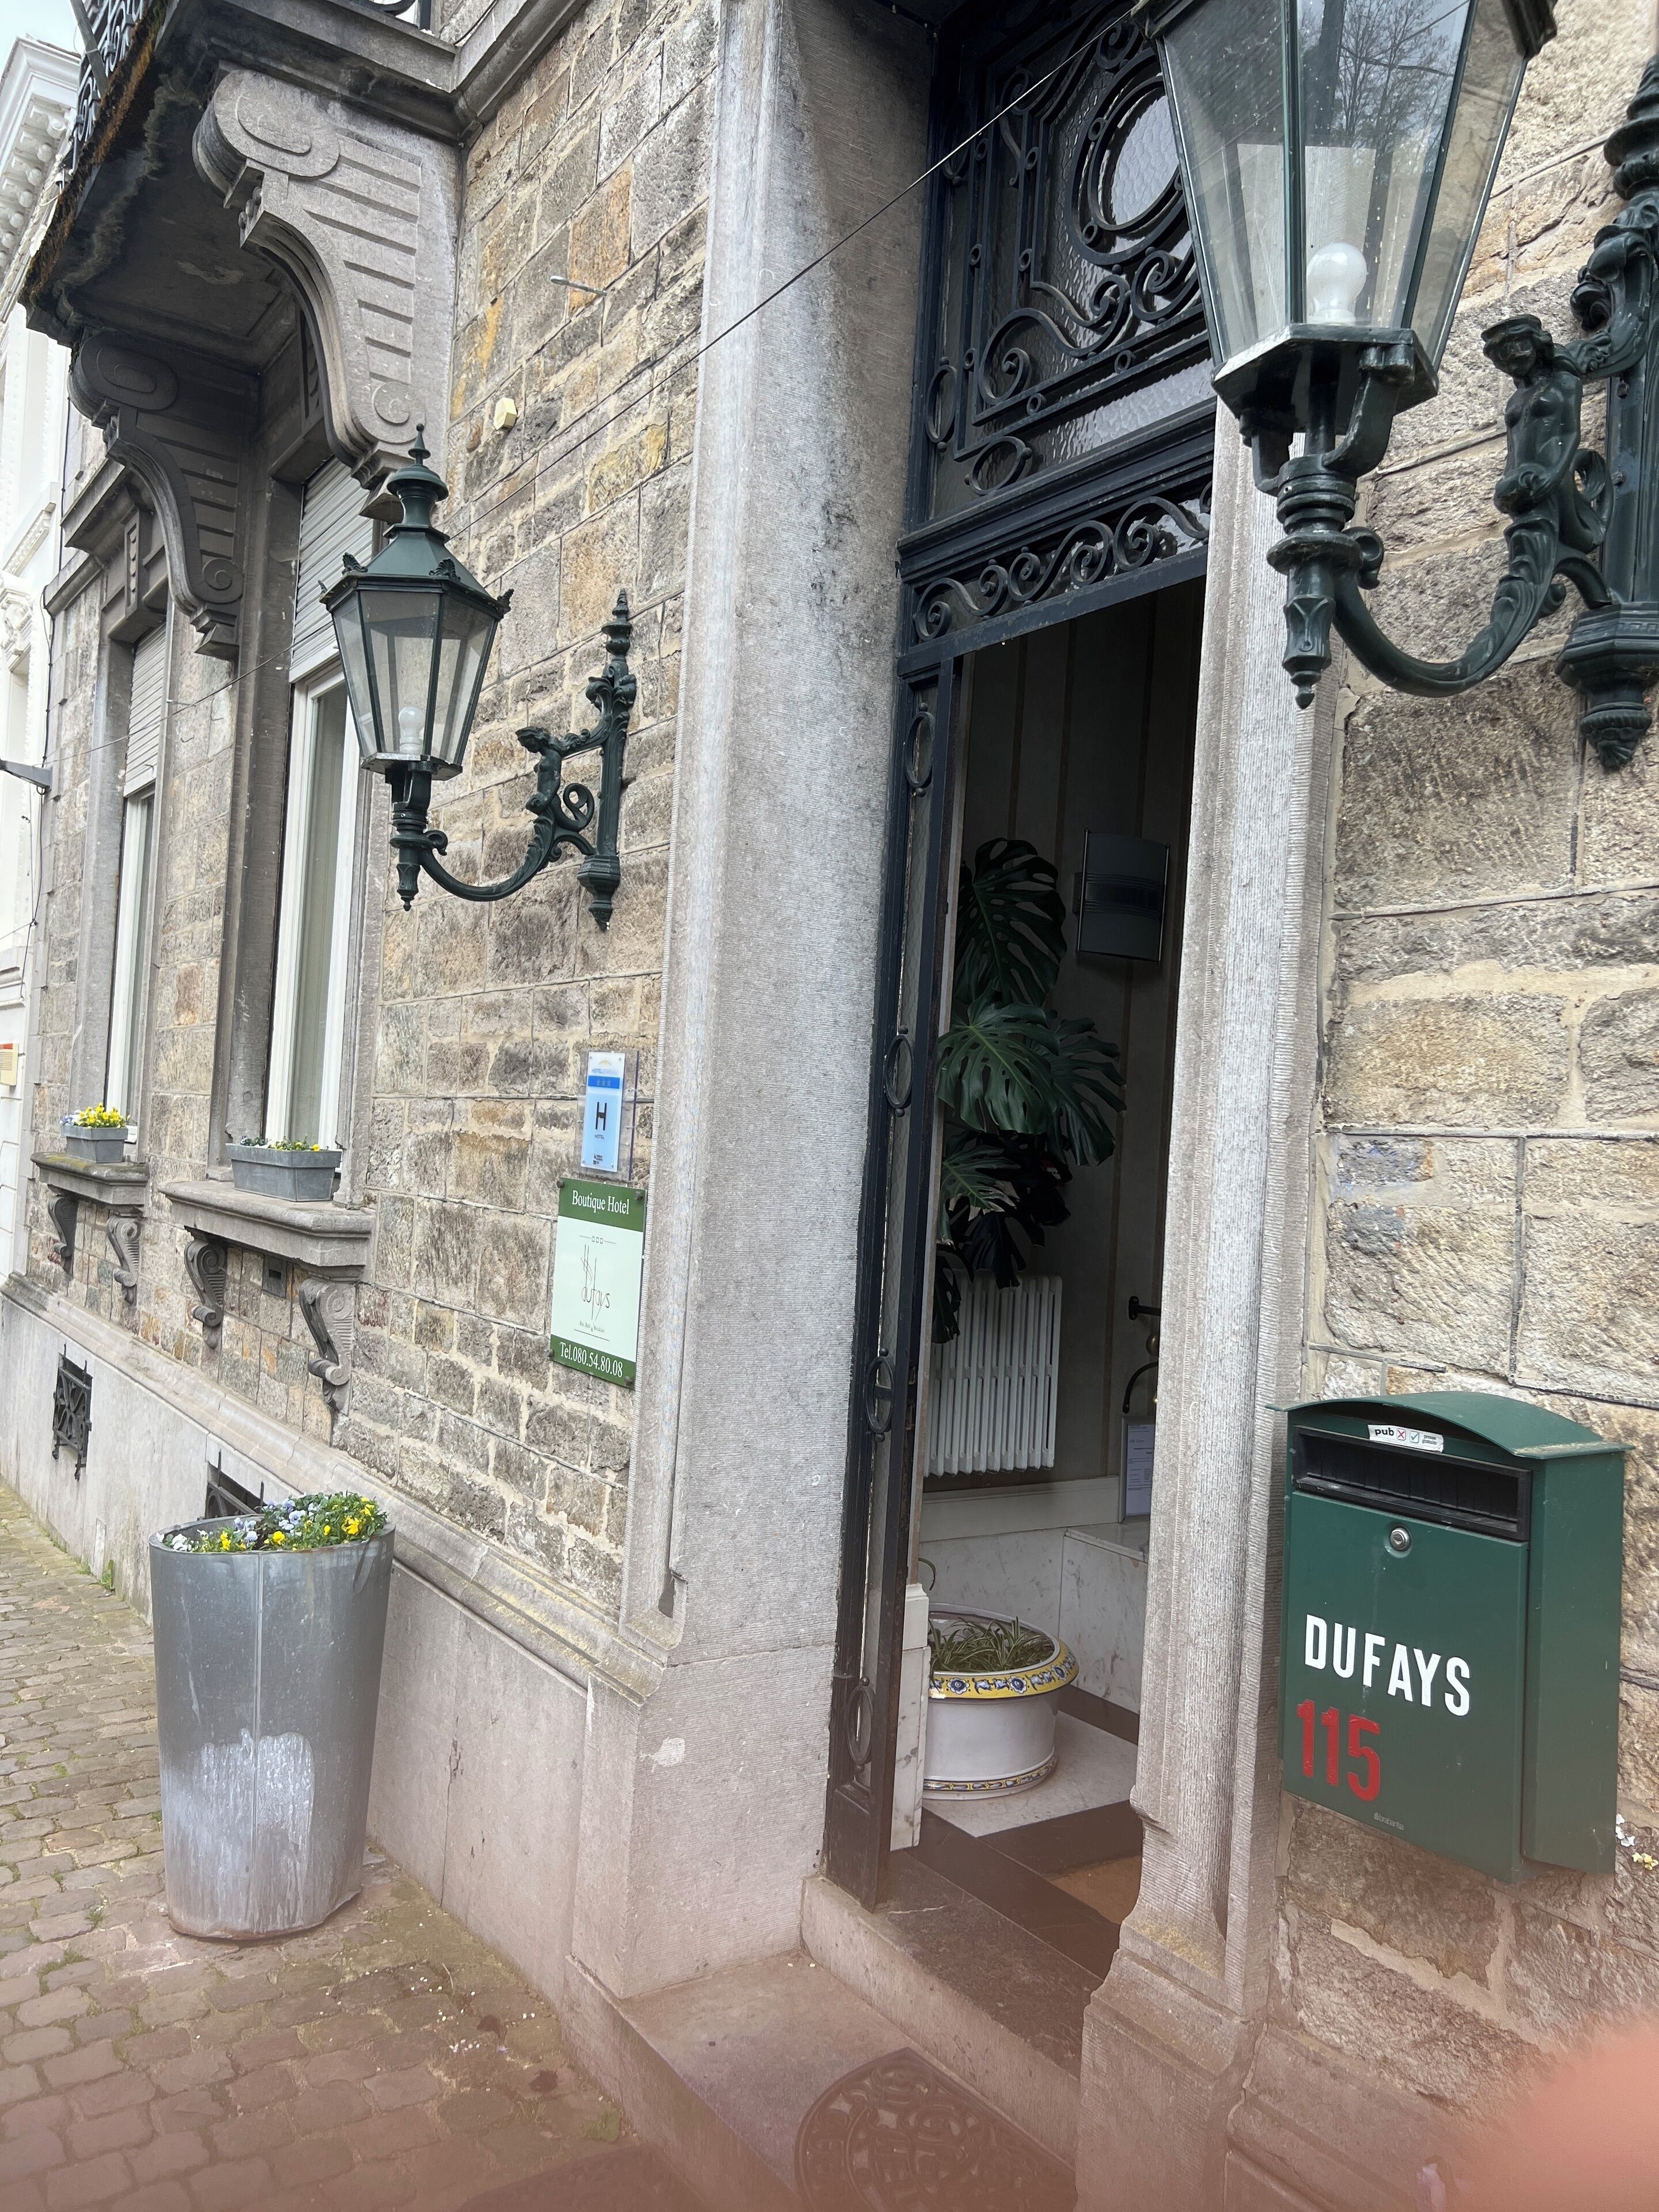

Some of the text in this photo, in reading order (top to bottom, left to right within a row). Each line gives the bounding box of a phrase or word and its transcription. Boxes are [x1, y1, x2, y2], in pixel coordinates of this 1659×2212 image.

[595, 1102, 607, 1131] H
[572, 1190, 629, 1214] Boutique Hotel
[560, 1341, 623, 1378] Tel.080.54.80.08
[1374, 1427, 1394, 1436] pub
[1305, 1614, 1470, 1716] DUFAYS
[1297, 1699, 1381, 1801] 115
